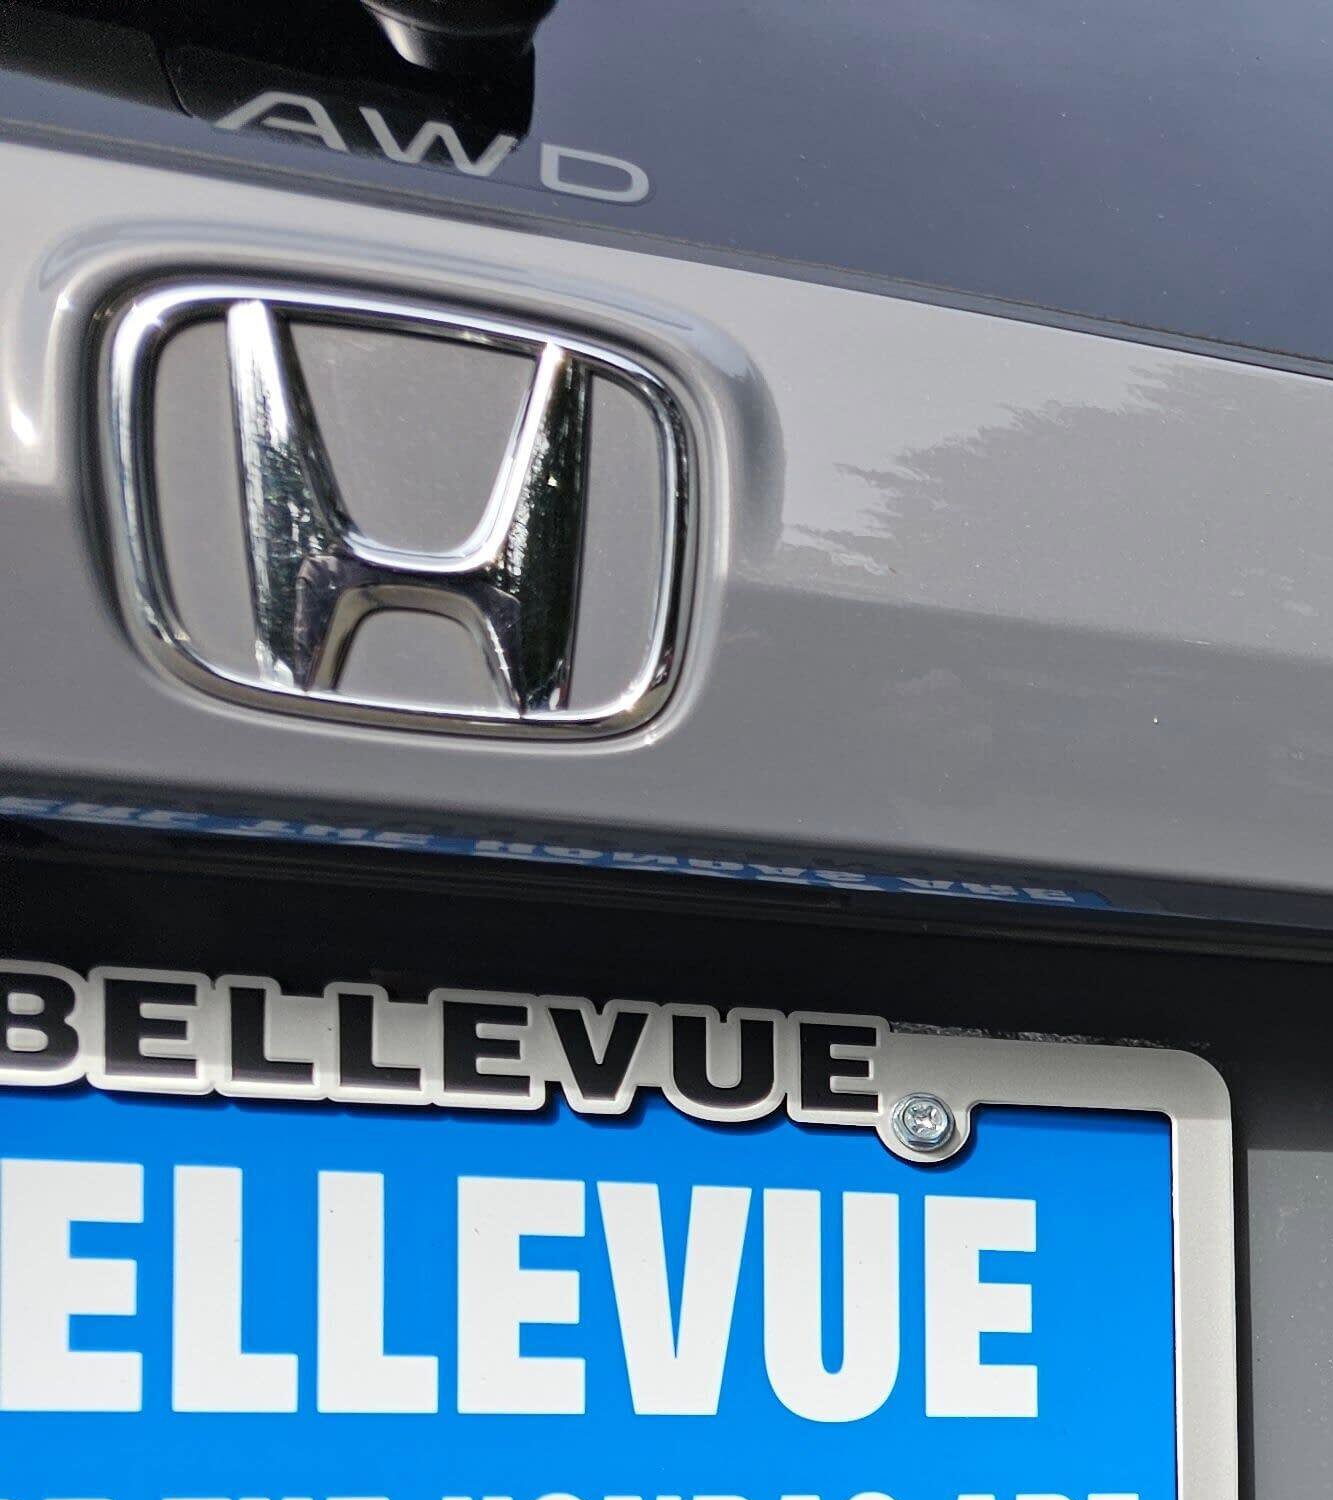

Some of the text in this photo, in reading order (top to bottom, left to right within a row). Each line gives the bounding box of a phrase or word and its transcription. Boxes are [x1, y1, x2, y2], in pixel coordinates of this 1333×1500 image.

[214, 91, 649, 202] AWD
[0, 971, 880, 1114] BELLEVUE
[0, 1158, 1038, 1421] ELLEVUE
